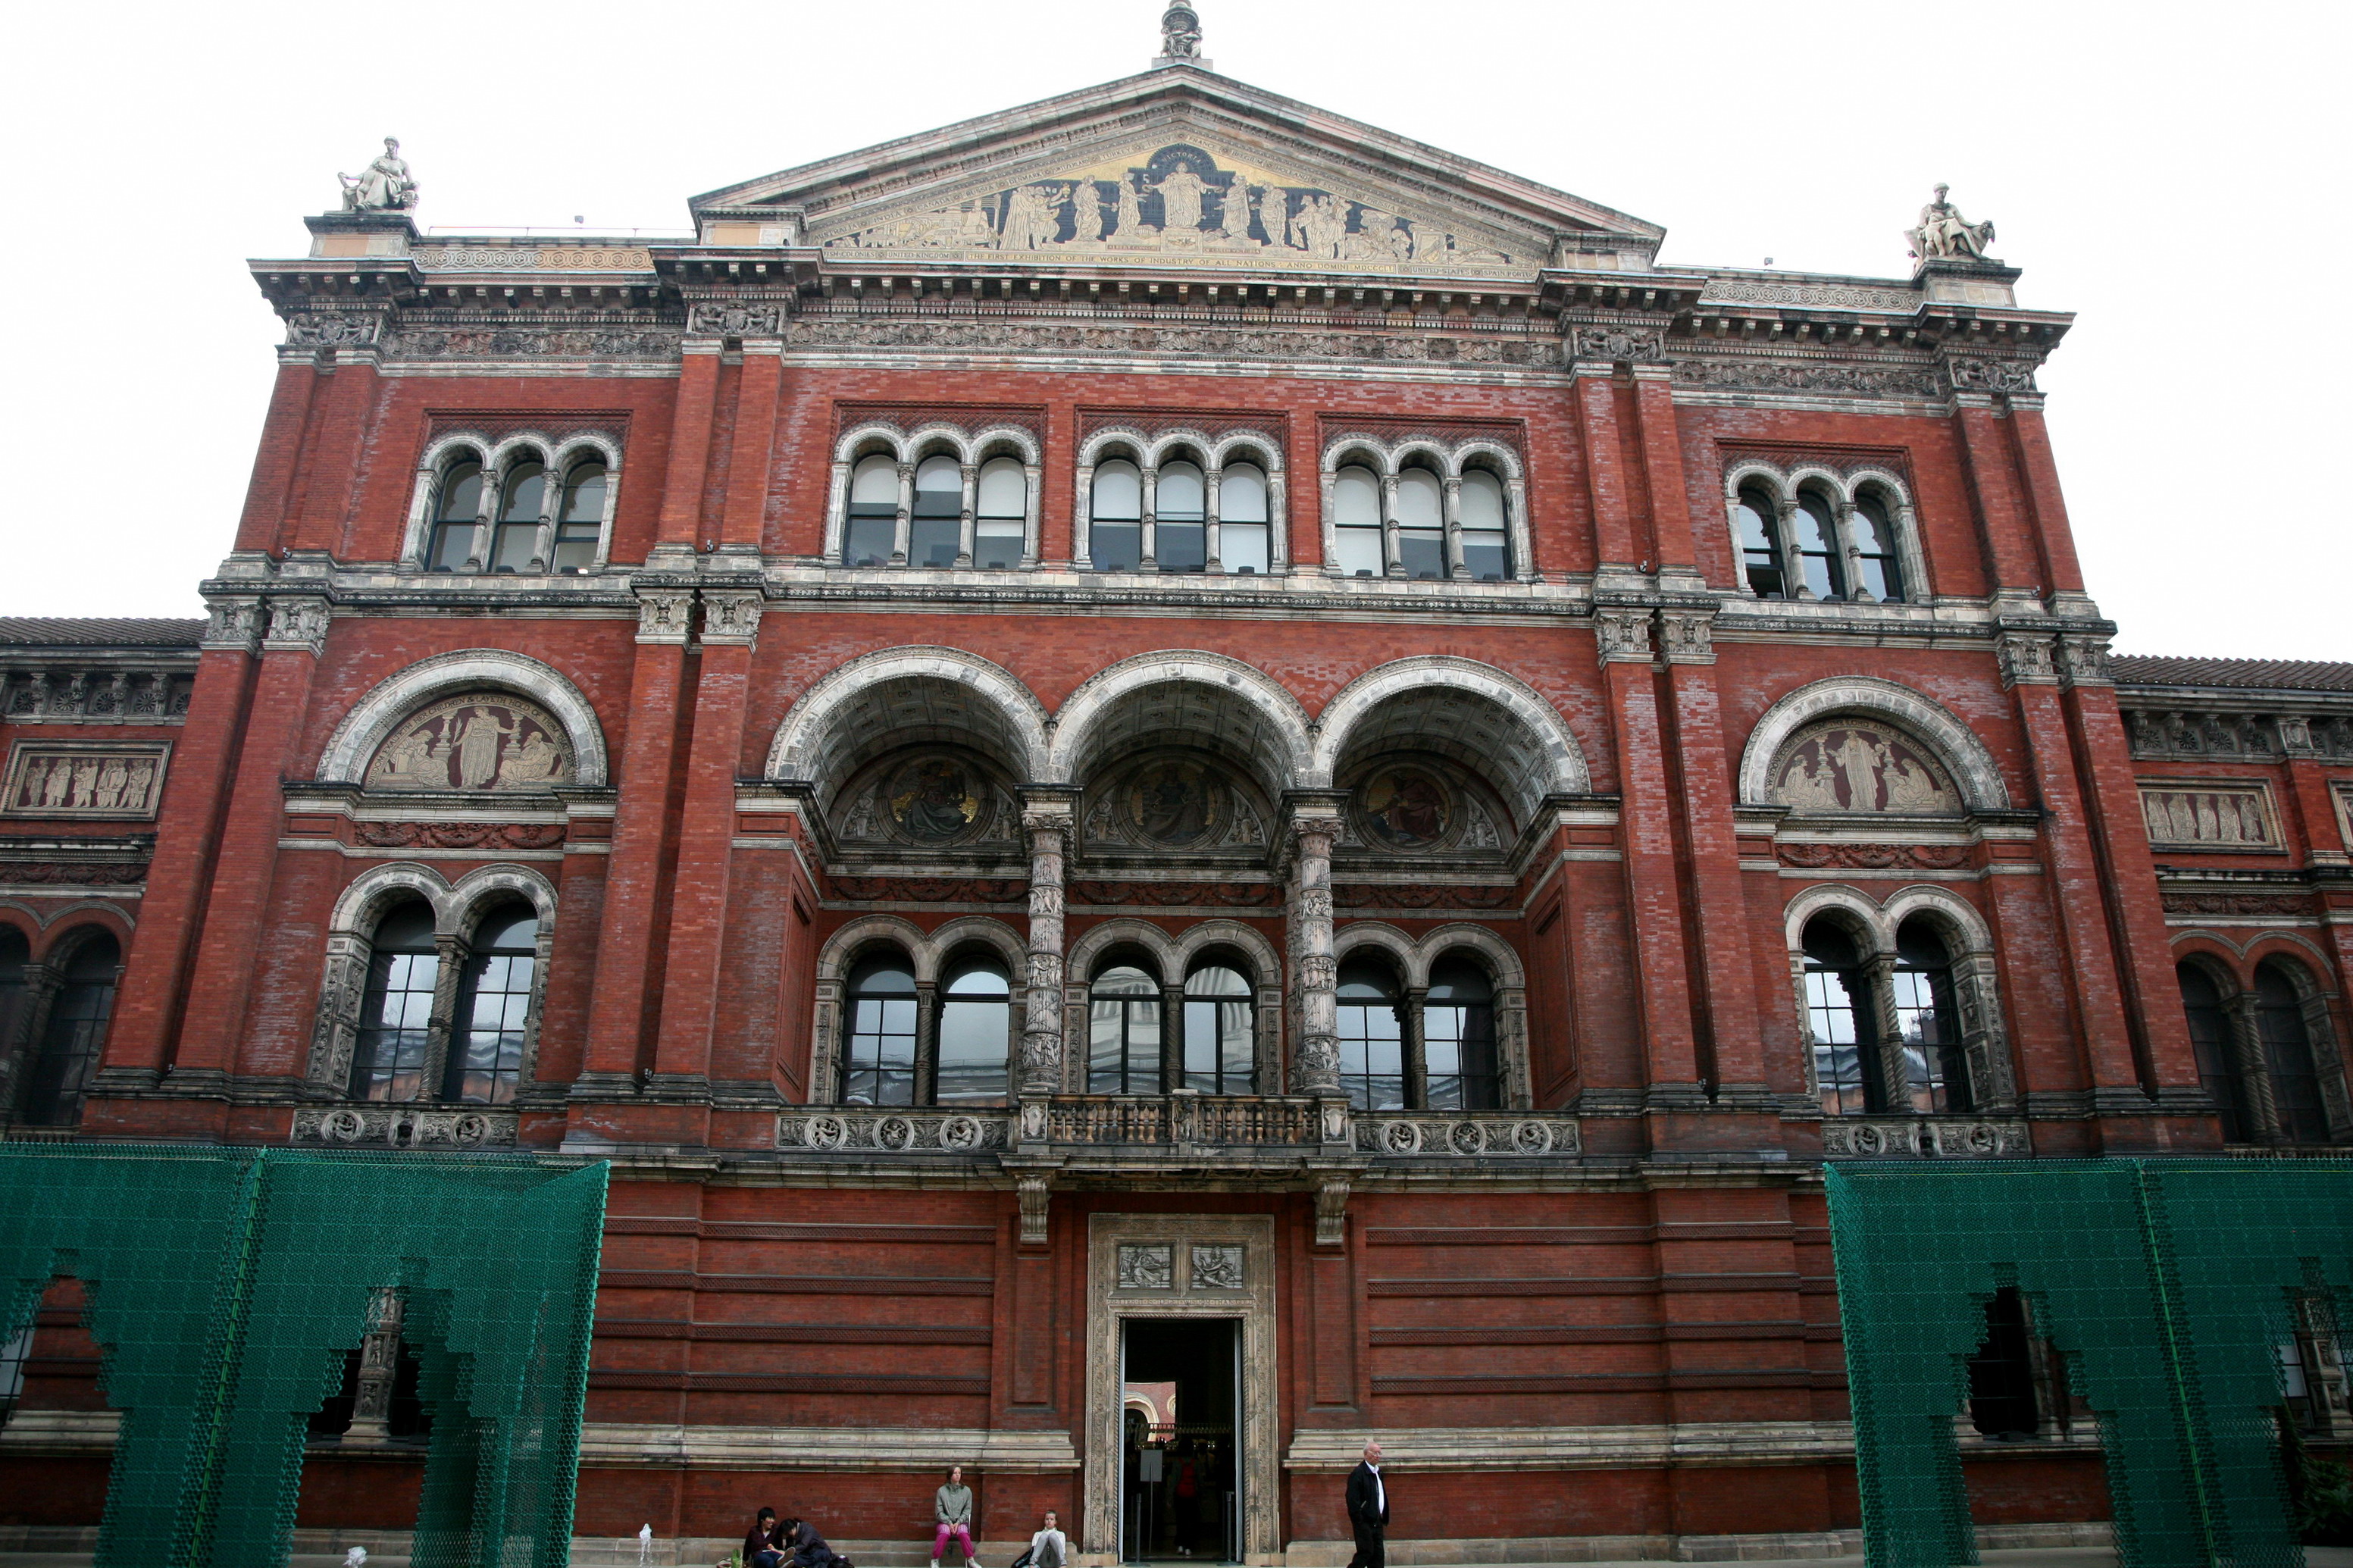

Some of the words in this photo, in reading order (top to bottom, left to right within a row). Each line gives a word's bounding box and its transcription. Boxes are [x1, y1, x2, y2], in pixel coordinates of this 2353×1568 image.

[1148, 136, 1172, 148] ITALY
[1187, 136, 1217, 149] FRANCE
[1102, 146, 1131, 160] TURKEY
[1162, 152, 1201, 164] VICTORIA
[1231, 151, 1263, 165] BELGIUM
[1008, 171, 1042, 186] DENMARK
[1275, 164, 1309, 180] HOLLAND
[965, 183, 995, 197] RUSSIA
[1323, 181, 1350, 196] EGYPT
[916, 196, 950, 210] CANADA
[1366, 198, 1396, 212] PRUSSIA
[873, 211, 903, 224] INDIA
[814, 222, 859, 240] AUSTRALIA
[1456, 228, 1486, 243] AUSTRIA
[368, 756, 385, 786] WISDOM
[413, 712, 428, 724] HER
[428, 697, 465, 715] CHILDREN
[476, 695, 506, 704] LAYETH
[509, 699, 530, 711] HOLD
[542, 716, 559, 733] THEM
[1766, 756, 1782, 786] WISDOM
[1873, 724, 1891, 734] AND
[1935, 765, 1948, 782] FOR
